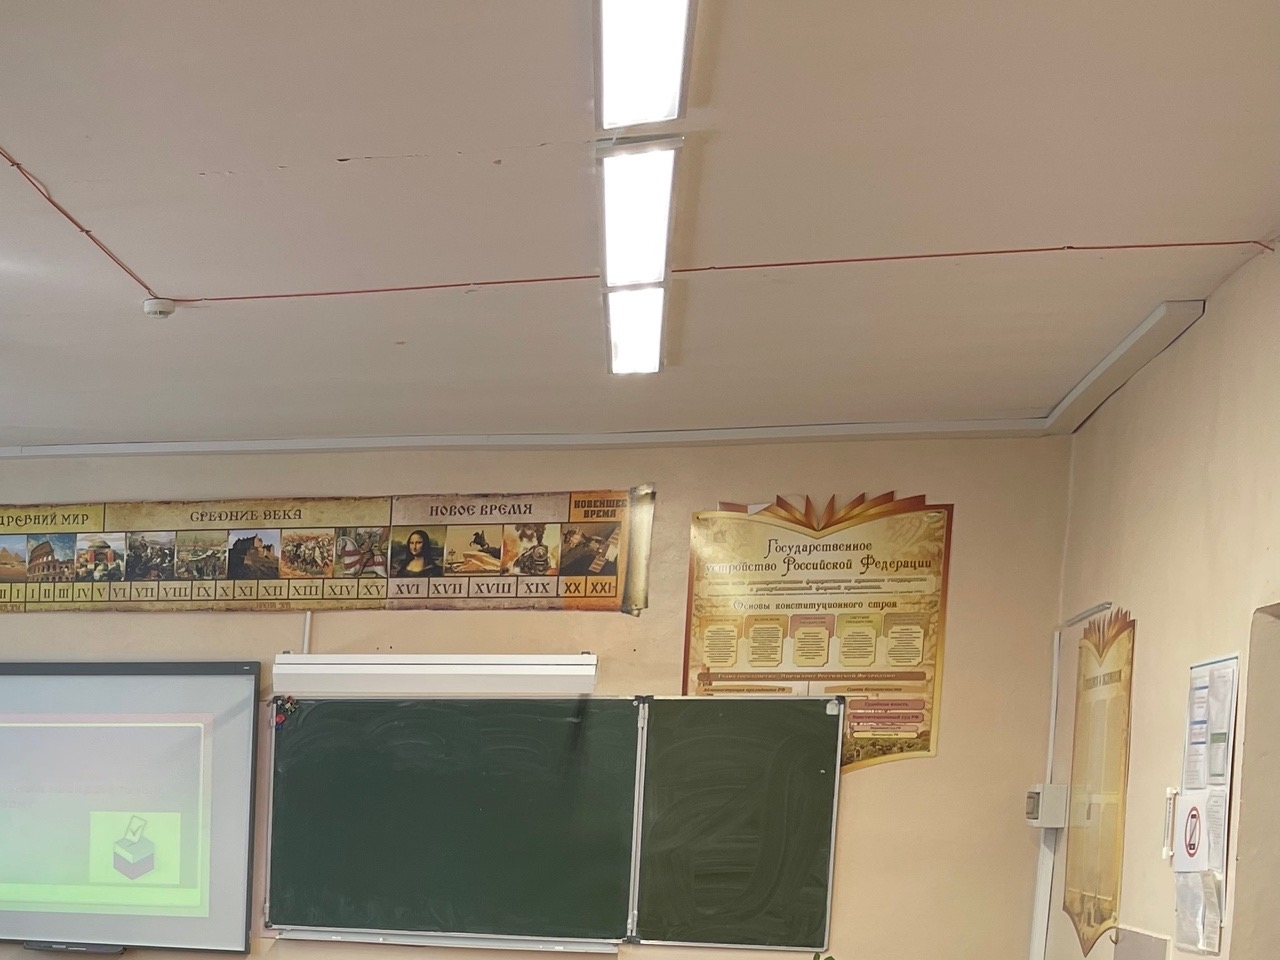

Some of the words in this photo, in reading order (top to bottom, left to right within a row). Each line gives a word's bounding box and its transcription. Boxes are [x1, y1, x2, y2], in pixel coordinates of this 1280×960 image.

[190, 510, 259, 522] СРЕДНИЕ
[263, 508, 302, 520] ВЕКА
[429, 504, 476, 516] НОВОЕ
[479, 503, 533, 515] ВРЕМЯ
[60, 513, 89, 525] МИР
[763, 538, 872, 559] Государственное
[705, 562, 777, 574] устройство
[781, 556, 853, 577] Российской
[859, 554, 932, 576] Федерации
[0, 589, 7, 600] II
[16, 589, 21, 599] I
[31, 588, 36, 599] I
[43, 588, 51, 599] II
[58, 588, 69, 599] III
[76, 587, 90, 599] IV
[96, 587, 106, 598] V
[196, 586, 212, 598] IX
[219, 586, 230, 598] X
[238, 586, 253, 598] XI
[261, 586, 283, 597] XII
[291, 585, 319, 597] XIII
[395, 583, 421, 595] XVI
[431, 582, 463, 595] XVII
[474, 582, 513, 594] XVIII
[523, 582, 551, 594] XIX
[564, 581, 582, 594] XX
[590, 580, 613, 594] XXI
[733, 600, 770, 610] Основы
[775, 601, 864, 612] конституционного
[867, 601, 898, 611] строя
